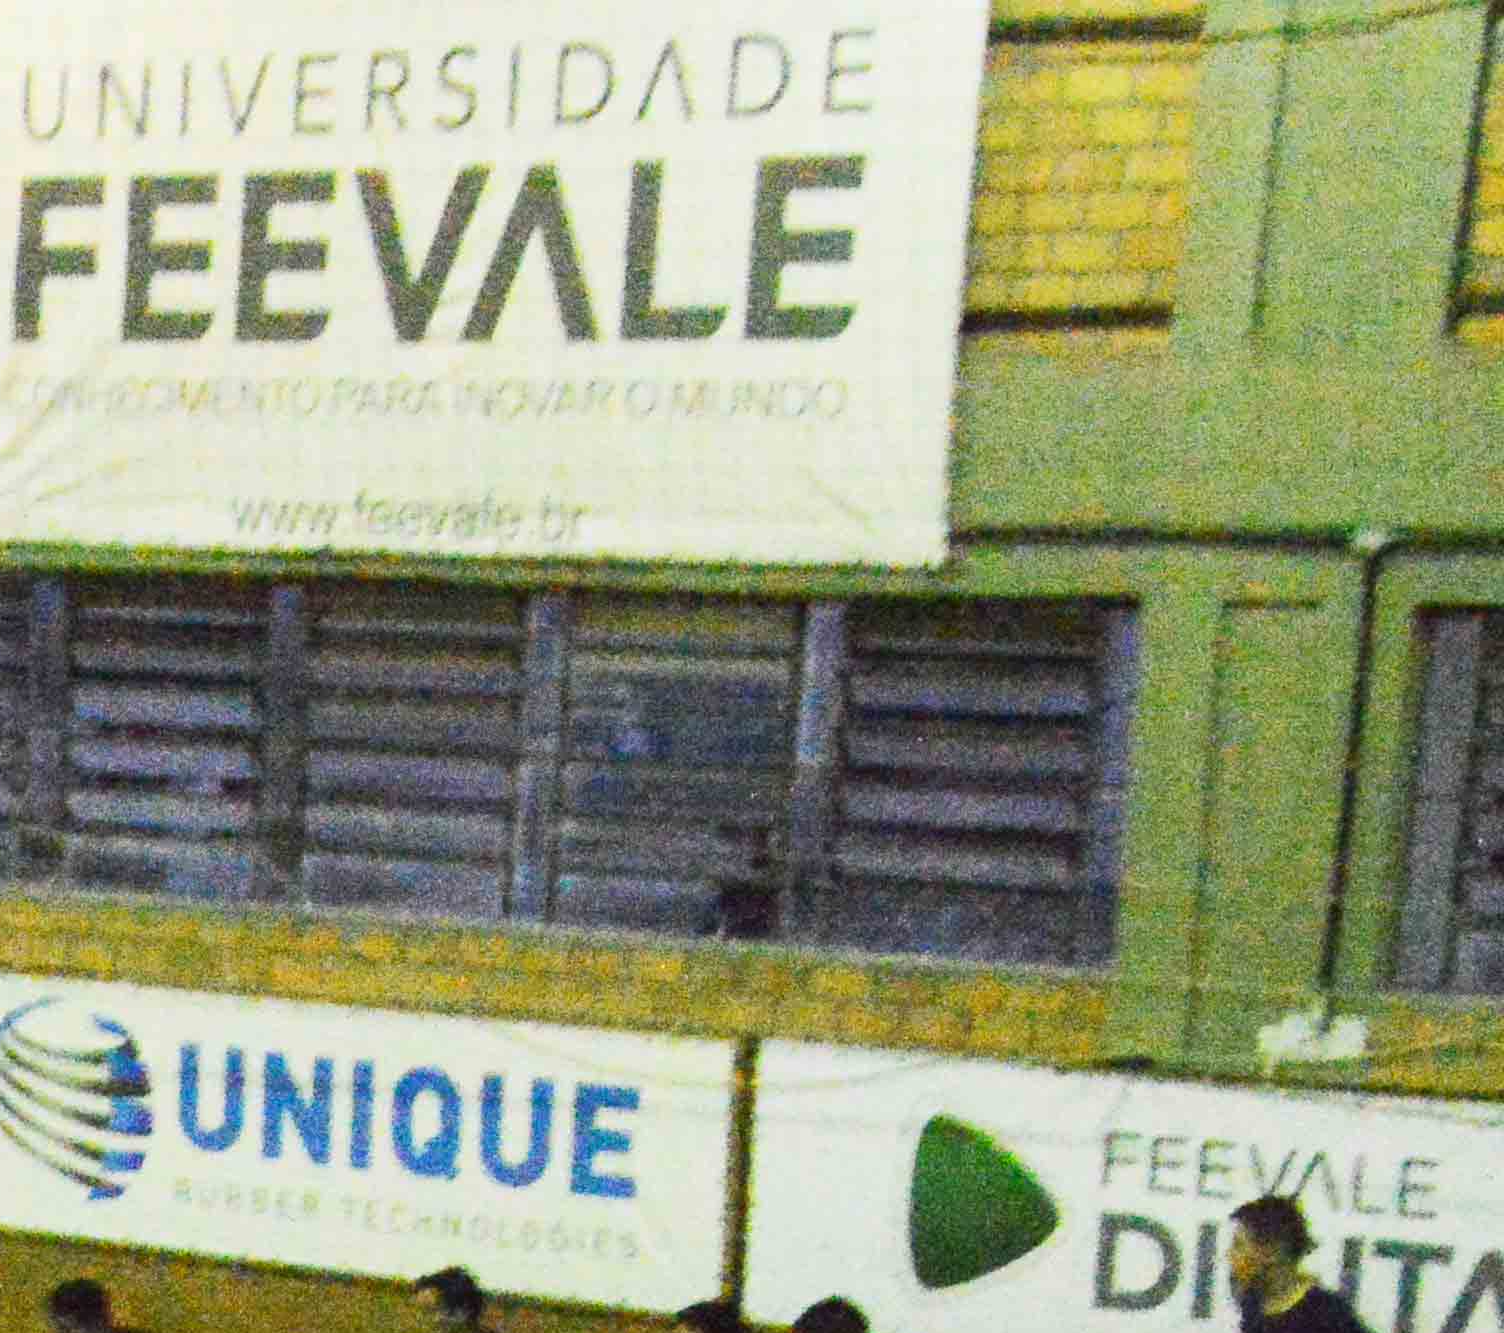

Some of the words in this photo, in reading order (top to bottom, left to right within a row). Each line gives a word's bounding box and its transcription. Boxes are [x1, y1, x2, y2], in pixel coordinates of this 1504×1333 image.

[24, 29, 875, 139] UNIVERSIDADE
[11, 154, 866, 343] FEEVALE
[178, 1042, 641, 1200] UNIQUE
[1099, 1130, 1440, 1222] FEEVALE
[172, 1176, 321, 1222] RUBBER
